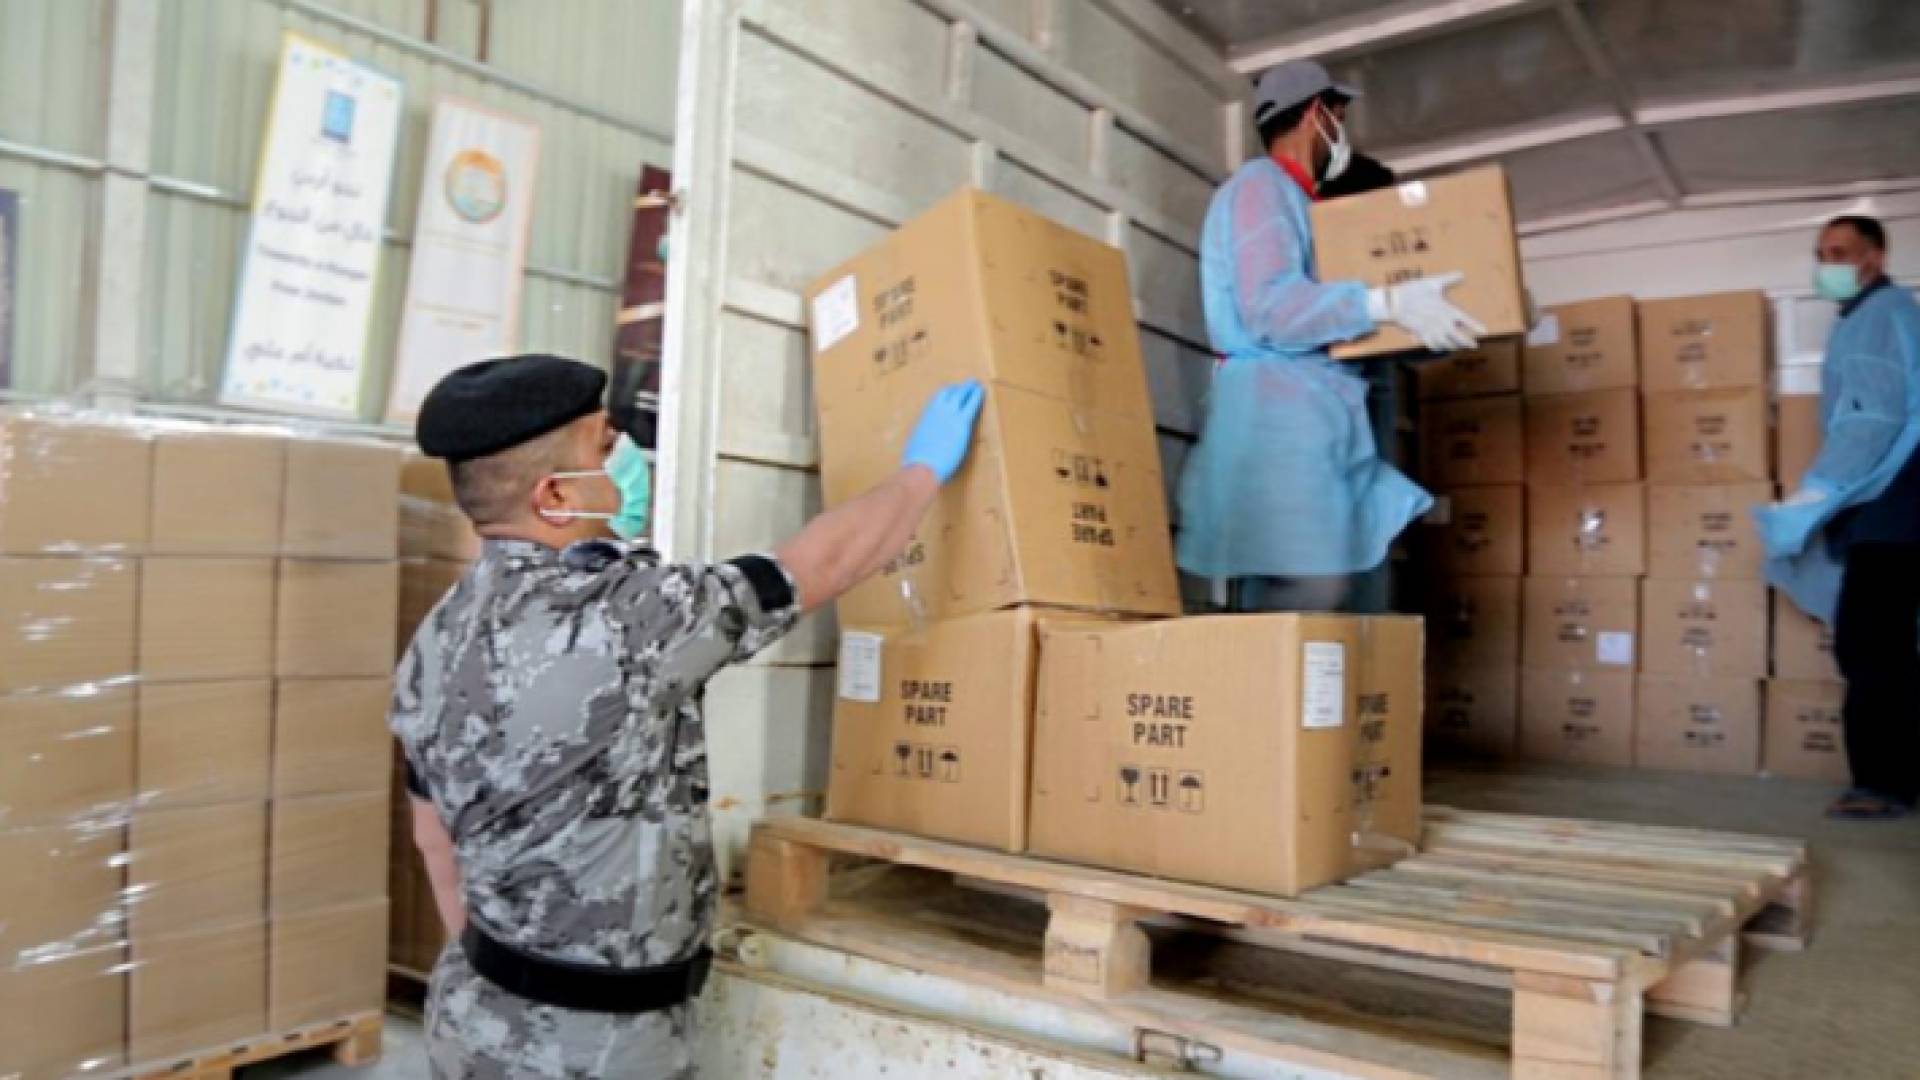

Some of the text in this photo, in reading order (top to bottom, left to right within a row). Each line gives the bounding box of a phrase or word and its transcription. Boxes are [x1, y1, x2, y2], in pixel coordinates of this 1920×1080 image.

[901, 679, 953, 703] SPARE
[904, 703, 947, 727] PART
[1127, 692, 1194, 719] SPARE
[1133, 720, 1187, 748] PART
